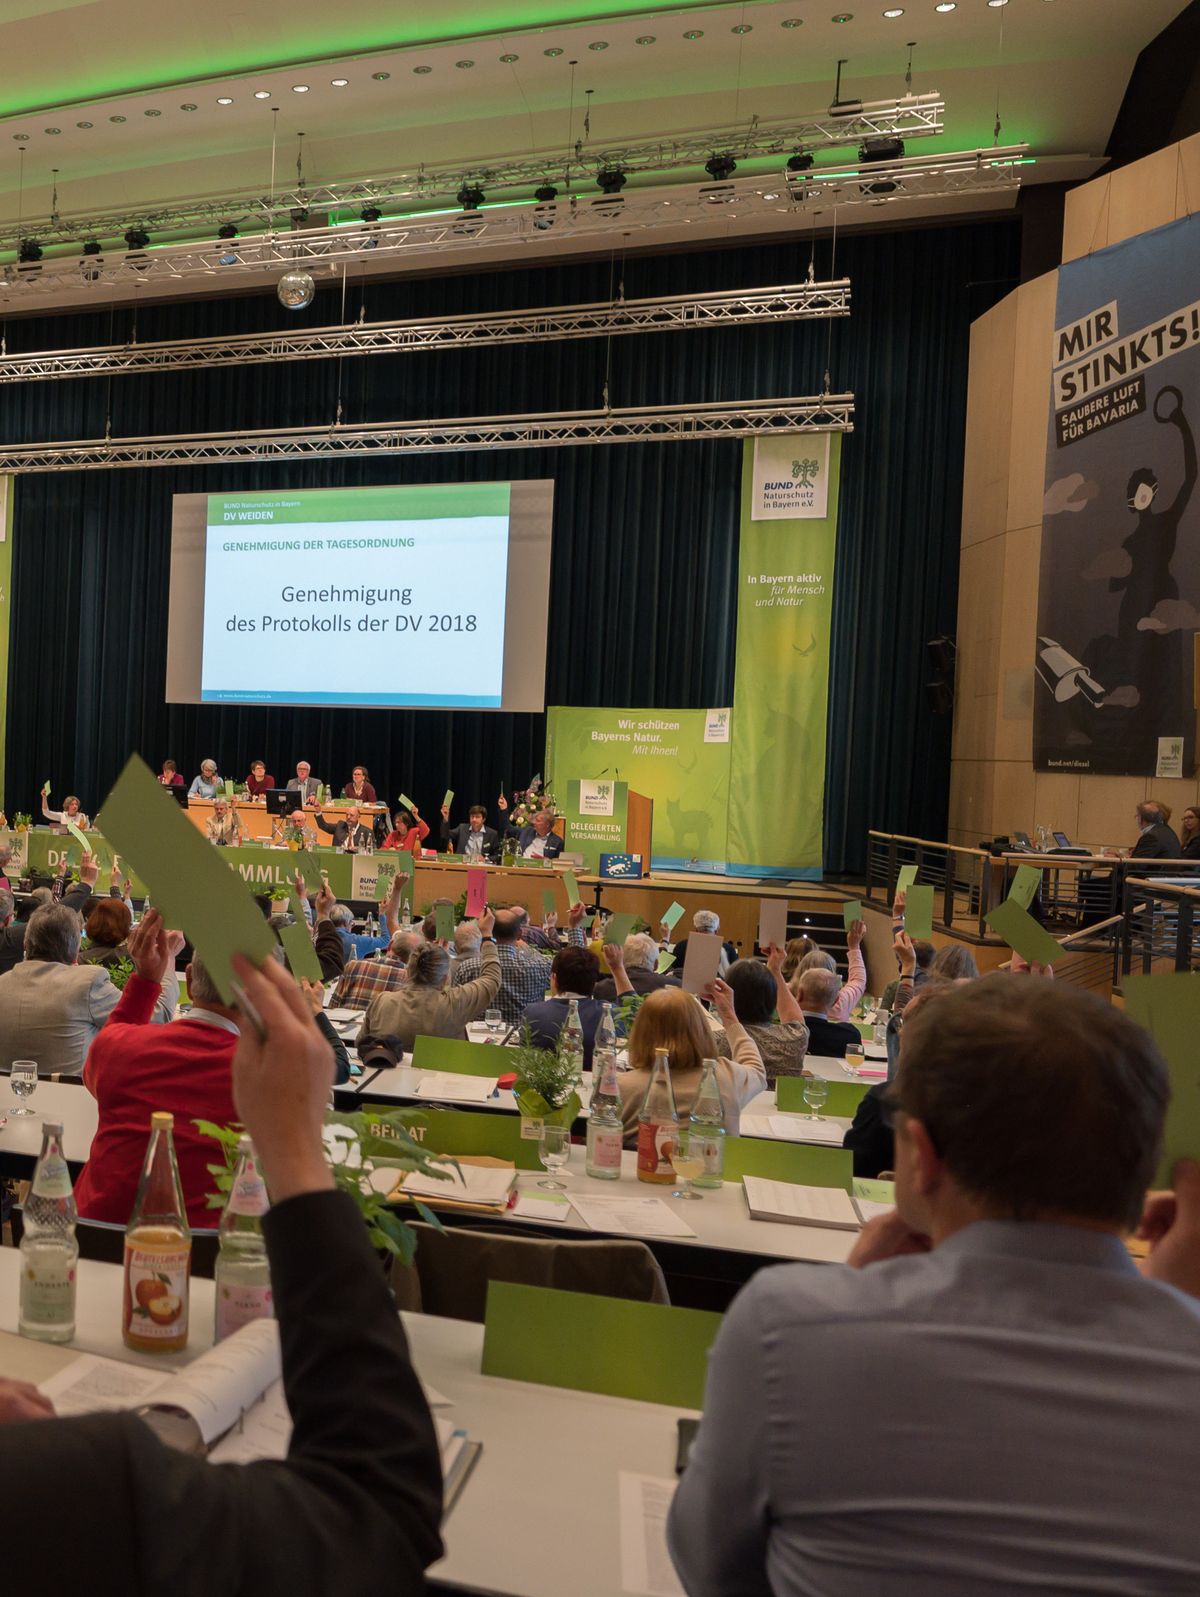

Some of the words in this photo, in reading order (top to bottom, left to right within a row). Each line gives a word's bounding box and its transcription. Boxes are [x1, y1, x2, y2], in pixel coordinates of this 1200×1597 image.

[1058, 310, 1113, 361] MIR
[1061, 308, 1200, 402] STINKTS!
[1061, 396, 1109, 426] SAUBERE
[1113, 381, 1140, 403] LUFT
[1062, 421, 1084, 442] FÜR
[1086, 399, 1139, 430] BAVARIA
[764, 481, 793, 490] BUND
[763, 491, 814, 500] Naturschutz
[772, 500, 800, 509] Bayern
[238, 511, 274, 520] WEIDEN
[223, 540, 300, 551] GENEHMIGUNG
[303, 540, 323, 550] DER
[327, 538, 415, 549] TAGESORDNUNG
[747, 575, 757, 584] In
[760, 574, 794, 585] Bayern
[796, 573, 822, 583] aktiv
[281, 584, 412, 606] Genehmigung
[770, 585, 785, 596] für
[787, 585, 825, 595] Mensch
[755, 598, 774, 607] und
[776, 597, 804, 606] Natur
[226, 615, 256, 632] des
[262, 614, 351, 632] Protokolls
[357, 614, 389, 632] der
[395, 615, 422, 632] DV
[428, 614, 477, 632] 2018
[618, 720, 635, 729] Wir
[637, 720, 680, 730] schützen
[591, 731, 631, 742] Bayerns
[633, 732, 662, 742] Natur.
[632, 745, 649, 755] Mit
[570, 822, 621, 833] DELEGIERTEN
[570, 831, 621, 841] VERSAMMLUNG
[370, 1123, 427, 1142] BEIAT
